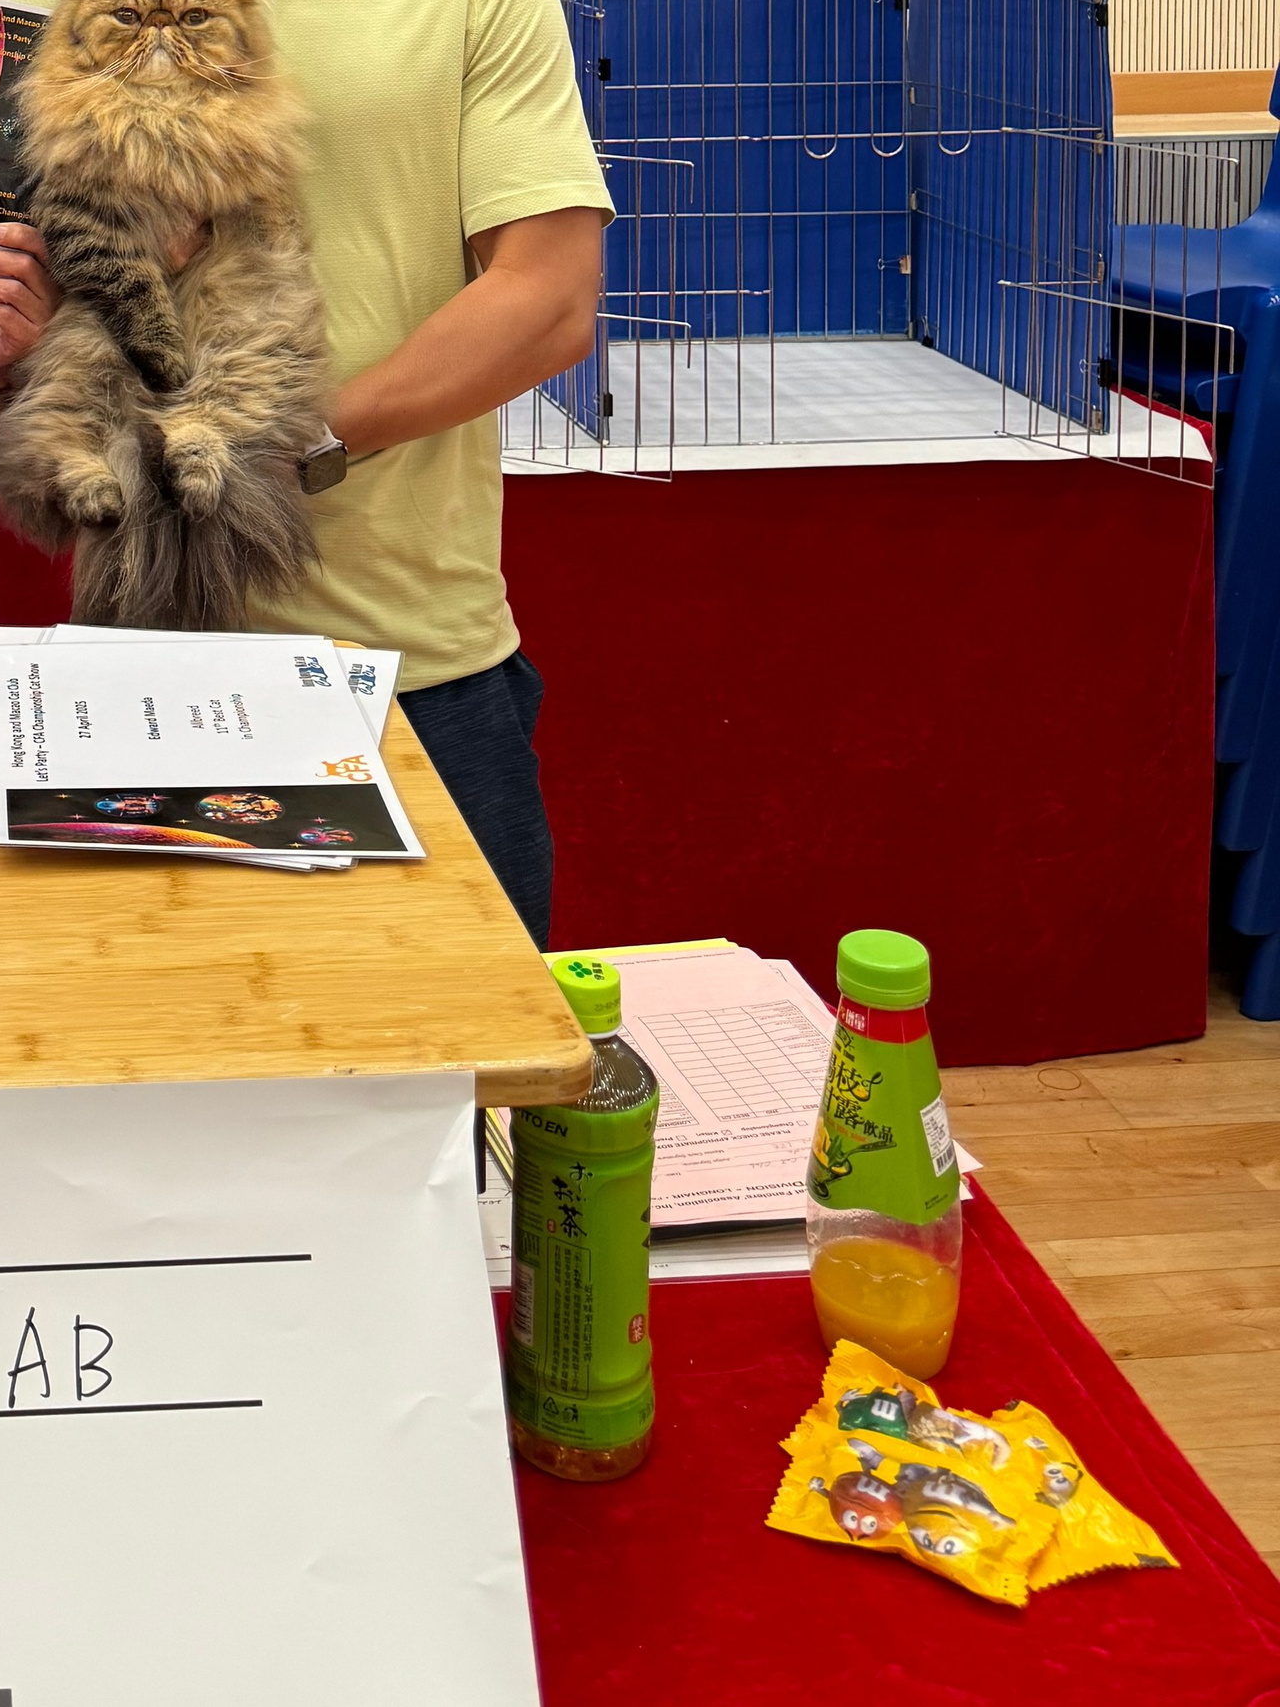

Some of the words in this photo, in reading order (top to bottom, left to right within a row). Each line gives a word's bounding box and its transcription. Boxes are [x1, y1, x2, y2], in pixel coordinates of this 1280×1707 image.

[16, 18, 40, 28] Macao
[13, 34, 32, 45] Party
[28, 663, 39, 680] Show
[6, 678, 19, 690] Club
[30, 681, 40, 690] Cat
[8, 691, 20, 700] Cat
[9, 701, 20, 720] Macao
[29, 691, 46, 731] Championship
[75, 701, 88, 714] 2025
[141, 697, 155, 716] Maeda
[209, 699, 221, 708] Cat
[212, 710, 225, 722] Best
[229, 694, 251, 732] Championship
[9, 722, 21, 733] and
[76, 715, 92, 730] April
[144, 718, 160, 740] Edward
[11, 734, 25, 750] Kong
[33, 732, 45, 743] CFA
[12, 751, 26, 768] Hong
[35, 750, 49, 766] Party
[35, 767, 48, 782] Let's
[340, 755, 373, 782] CFA
[520, 1110, 543, 1128] ITO
[544, 1120, 568, 1137] EN
[675, 1135, 729, 1147] APPROPRIATE
[671, 1188, 731, 1199] LONGHAIR
[746, 1180, 805, 1192] DIVISION
[6, 1306, 115, 1409] AB
